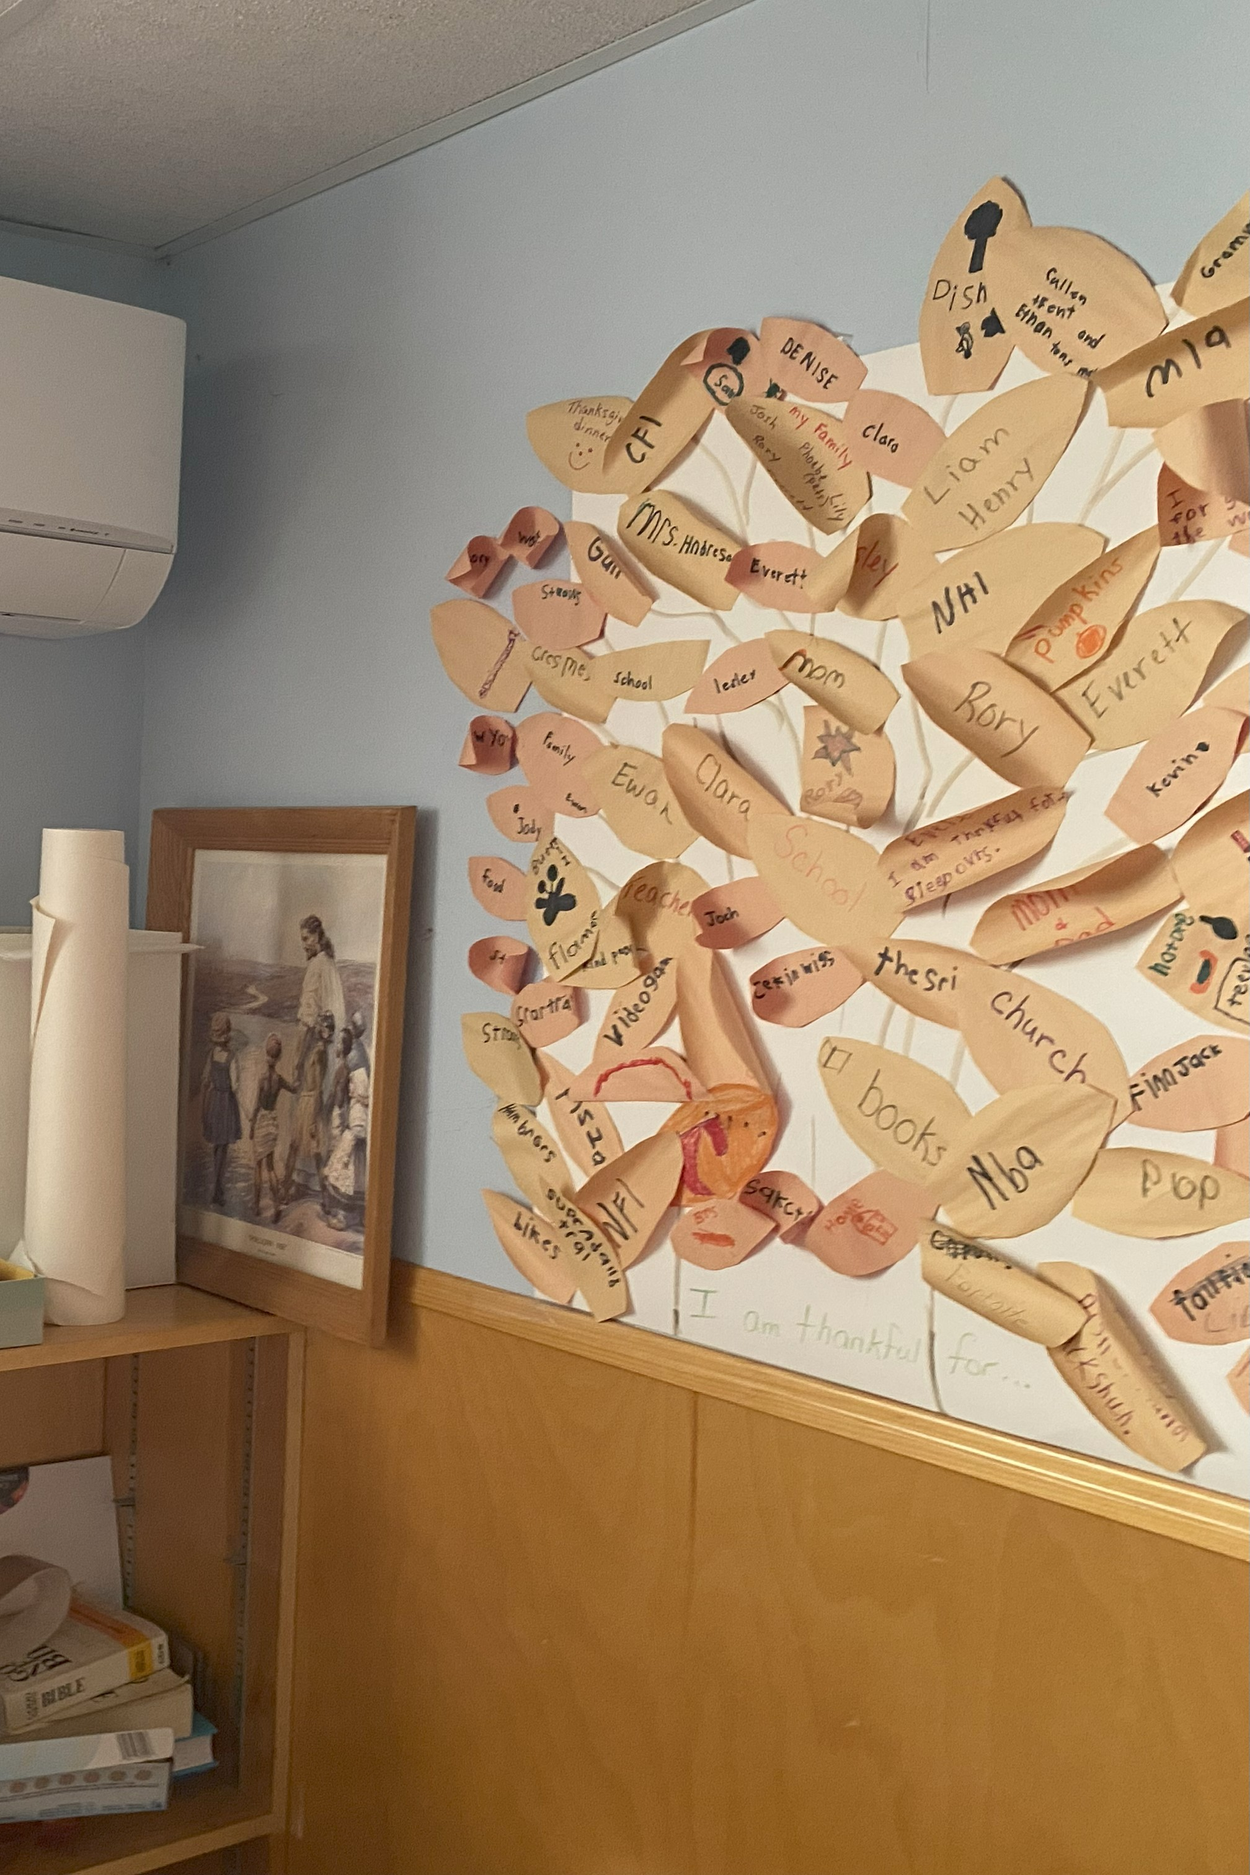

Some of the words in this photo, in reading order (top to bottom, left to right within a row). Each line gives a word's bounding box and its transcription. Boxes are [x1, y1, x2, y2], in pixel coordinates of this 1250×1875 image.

[932, 279, 987, 312] Dish
[781, 337, 838, 390] DENISE
[749, 404, 779, 430] Josh
[752, 435, 781, 463] Rory
[799, 442, 827, 481] Phoebe
[923, 427, 1010, 505] Liam
[958, 457, 1034, 530] Henry
[749, 557, 807, 589] Everett
[1081, 616, 1193, 719] Everett
[953, 680, 1039, 758] Rory
[611, 761, 673, 825] Ewan
[695, 753, 750, 822] Clara
[1146, 750, 1198, 797] Kevin
[773, 823, 867, 913] School
[991, 991, 1089, 1084] Church
[859, 1068, 947, 1167] books
[966, 1146, 1044, 1210] Nba
[690, 1287, 717, 1319] I
[743, 1309, 781, 1337] am
[796, 1303, 922, 1365] thankful
